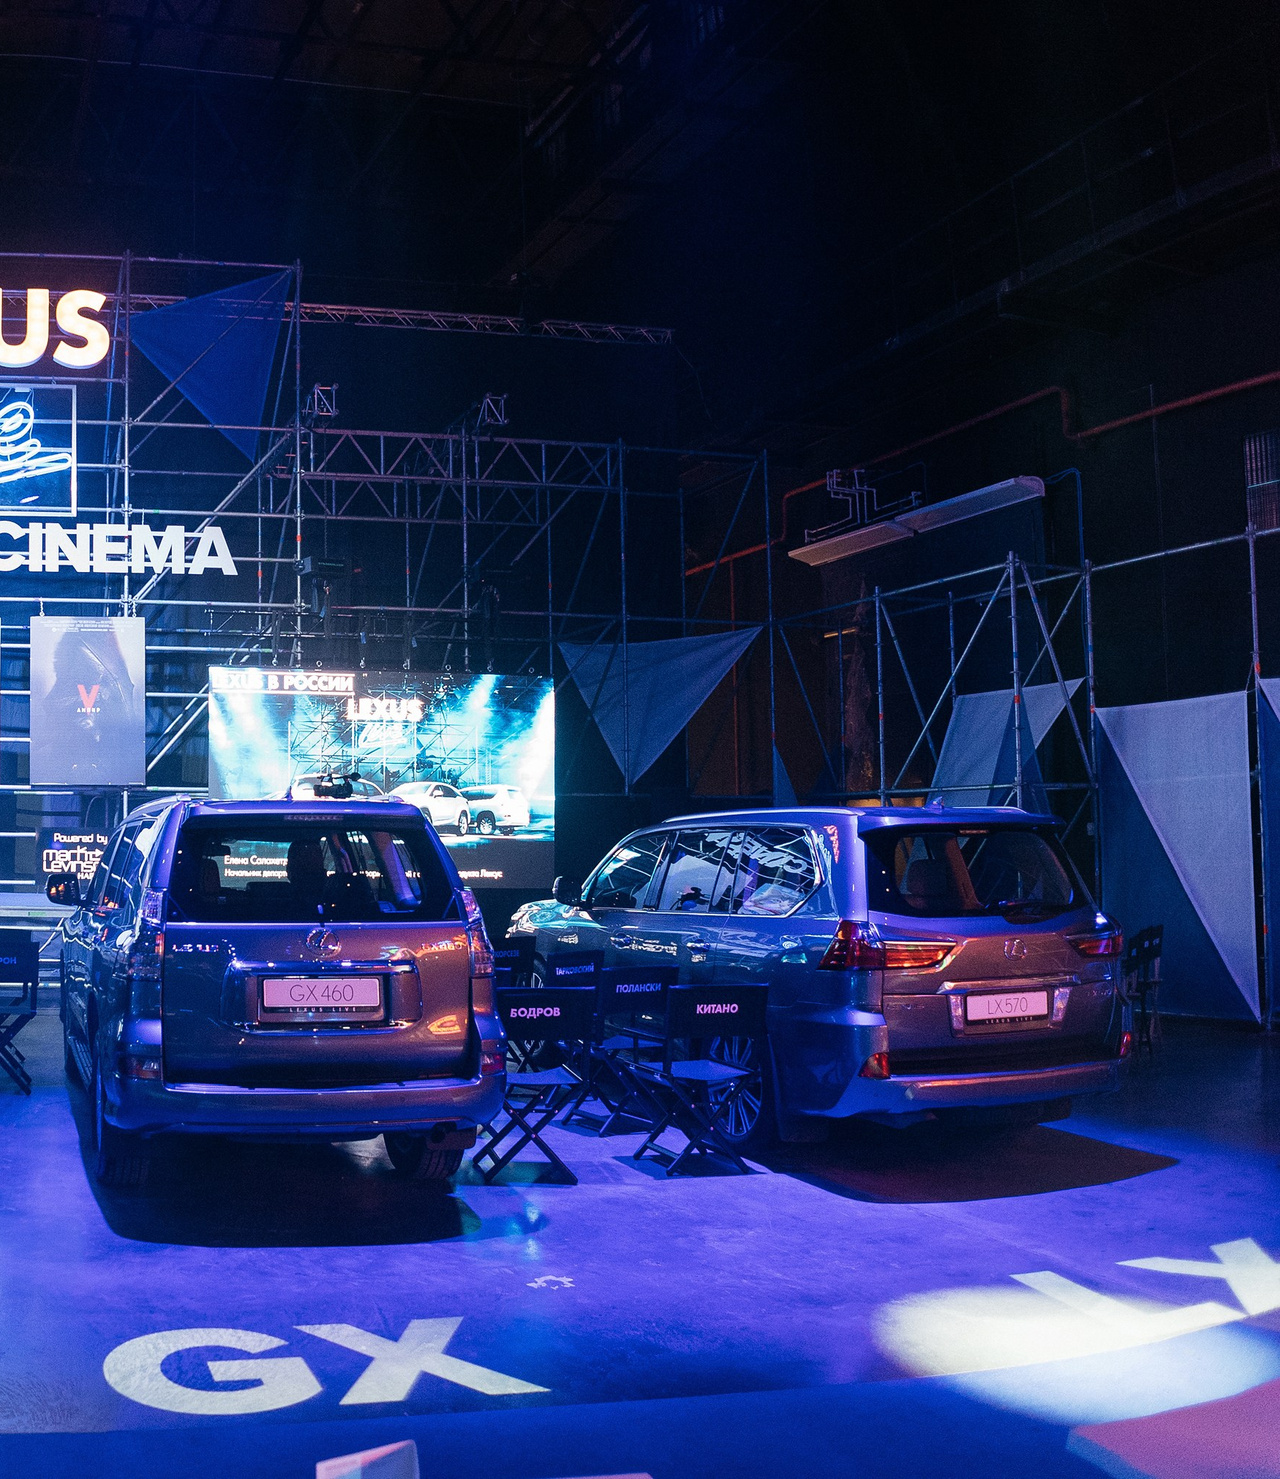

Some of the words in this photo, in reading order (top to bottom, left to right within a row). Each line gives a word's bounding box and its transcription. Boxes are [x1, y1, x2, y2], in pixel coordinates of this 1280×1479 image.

[283, 675, 353, 691] РОССИИ
[347, 698, 424, 722] LEXUS
[53, 832, 94, 842] Powered
[96, 833, 108, 845] by
[43, 860, 100, 872] Levins
[494, 950, 520, 958] КОРСЕЗЕ
[616, 982, 662, 993] ПОЛАНСКИ
[510, 1006, 561, 1019] БОДРОВ
[696, 1003, 739, 1014] КИТАНО
[102, 1316, 552, 1415] GX
